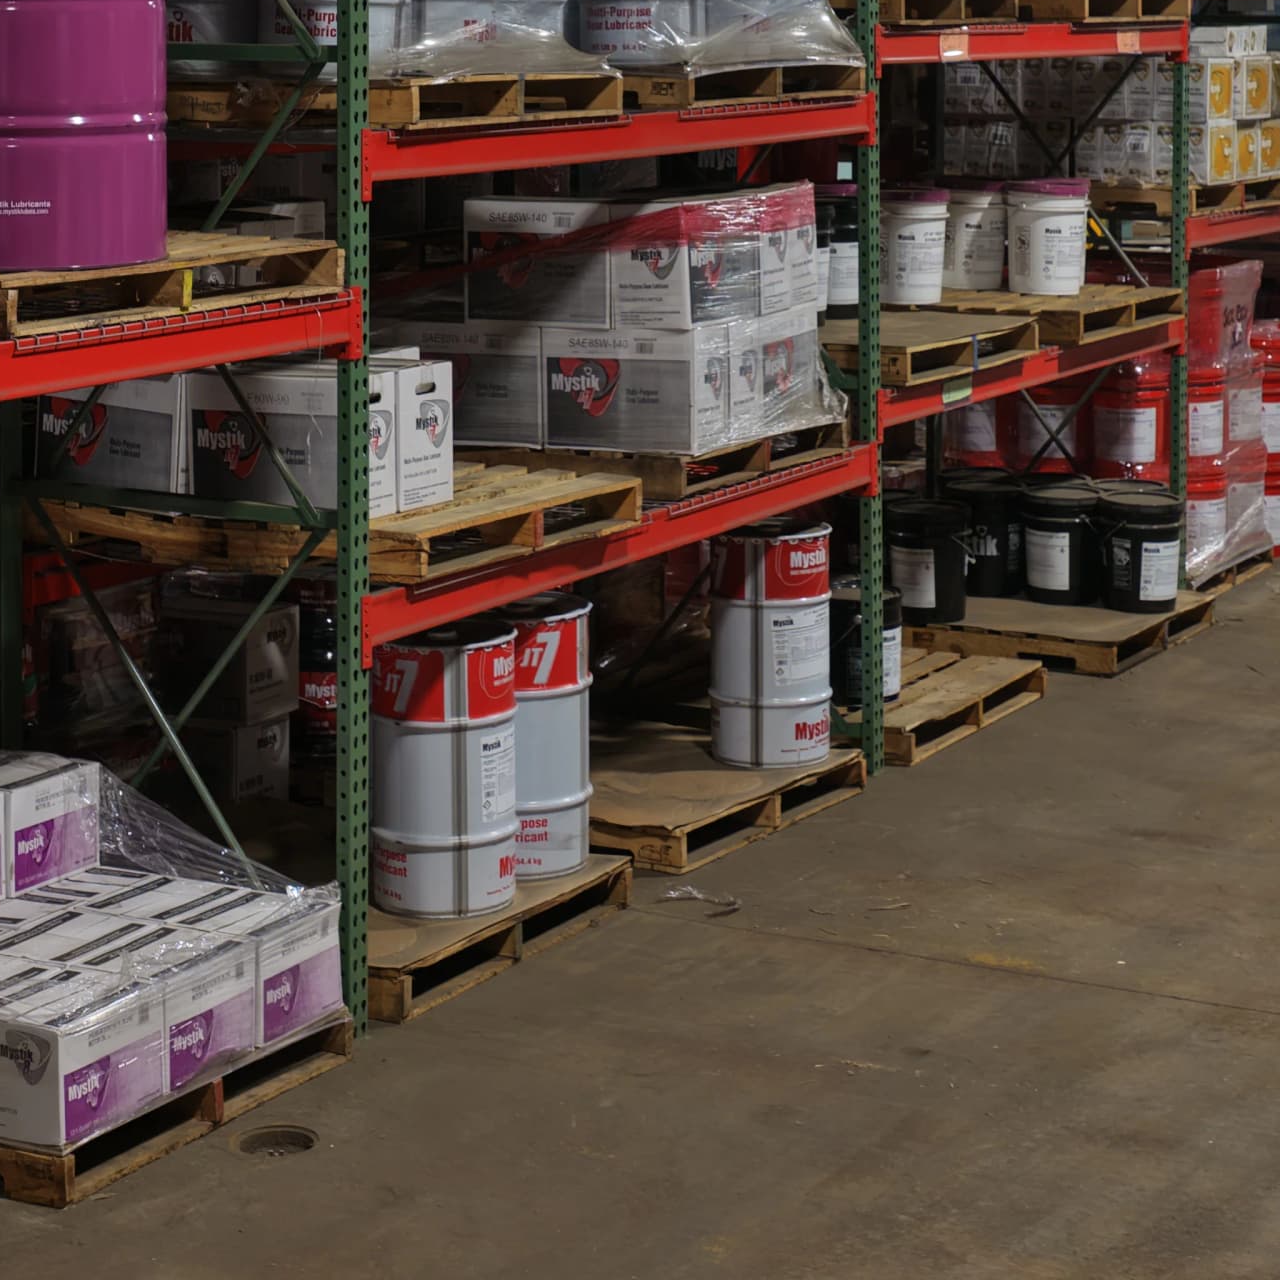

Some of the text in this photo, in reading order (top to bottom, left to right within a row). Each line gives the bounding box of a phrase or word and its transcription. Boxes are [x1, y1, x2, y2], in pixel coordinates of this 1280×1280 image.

[10, 200, 51, 209] Lubricants
[631, 248, 664, 261] Mystik
[551, 372, 600, 394] Mystik
[415, 414, 439, 433] Mystik
[196, 426, 247, 451] Mystik
[772, 618, 794, 628] Mystik
[305, 682, 338, 699] Myst
[482, 739, 501, 752] Mystik
[17, 837, 45, 856] Mystik
[266, 983, 293, 1010] Mystik
[173, 1024, 205, 1051] Mystik
[67, 1074, 103, 1101] Mystik
